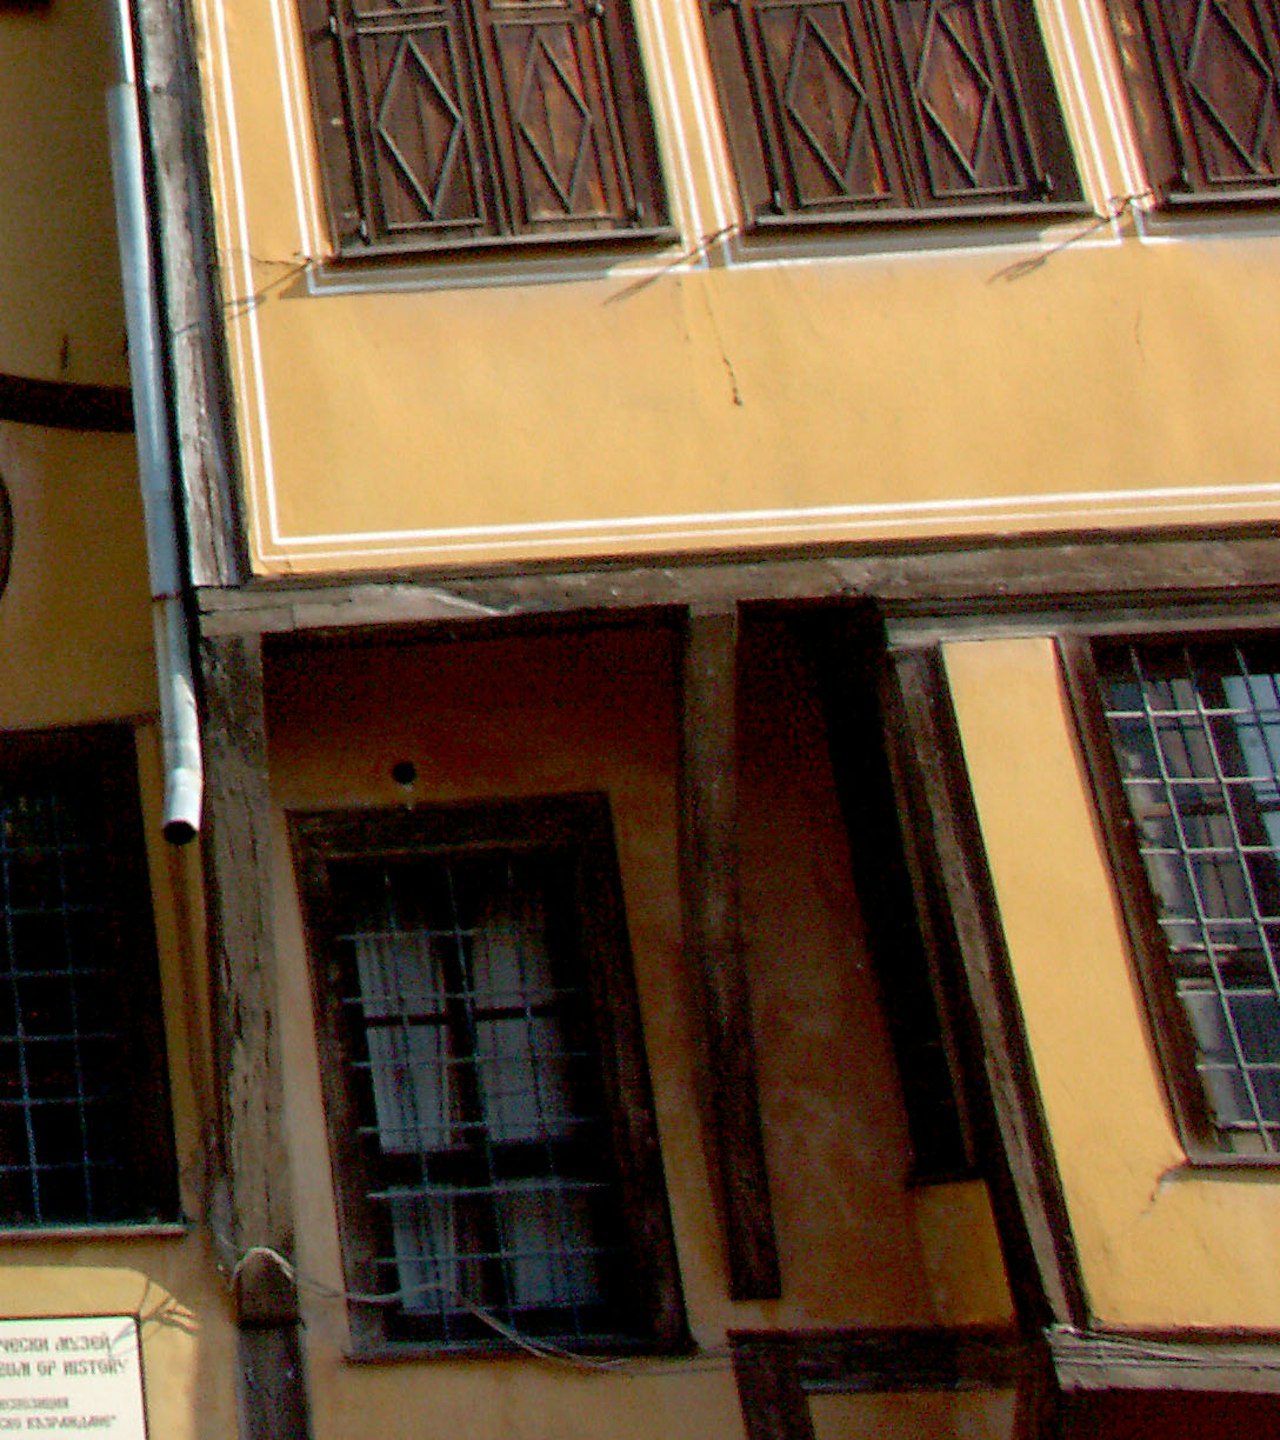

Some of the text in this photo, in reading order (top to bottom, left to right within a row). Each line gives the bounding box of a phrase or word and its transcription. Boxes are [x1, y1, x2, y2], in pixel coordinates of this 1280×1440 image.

[55, 1333, 110, 1353] МУЗЕЙ
[37, 1360, 56, 1376] OF
[63, 1358, 127, 1376] HISTORY
